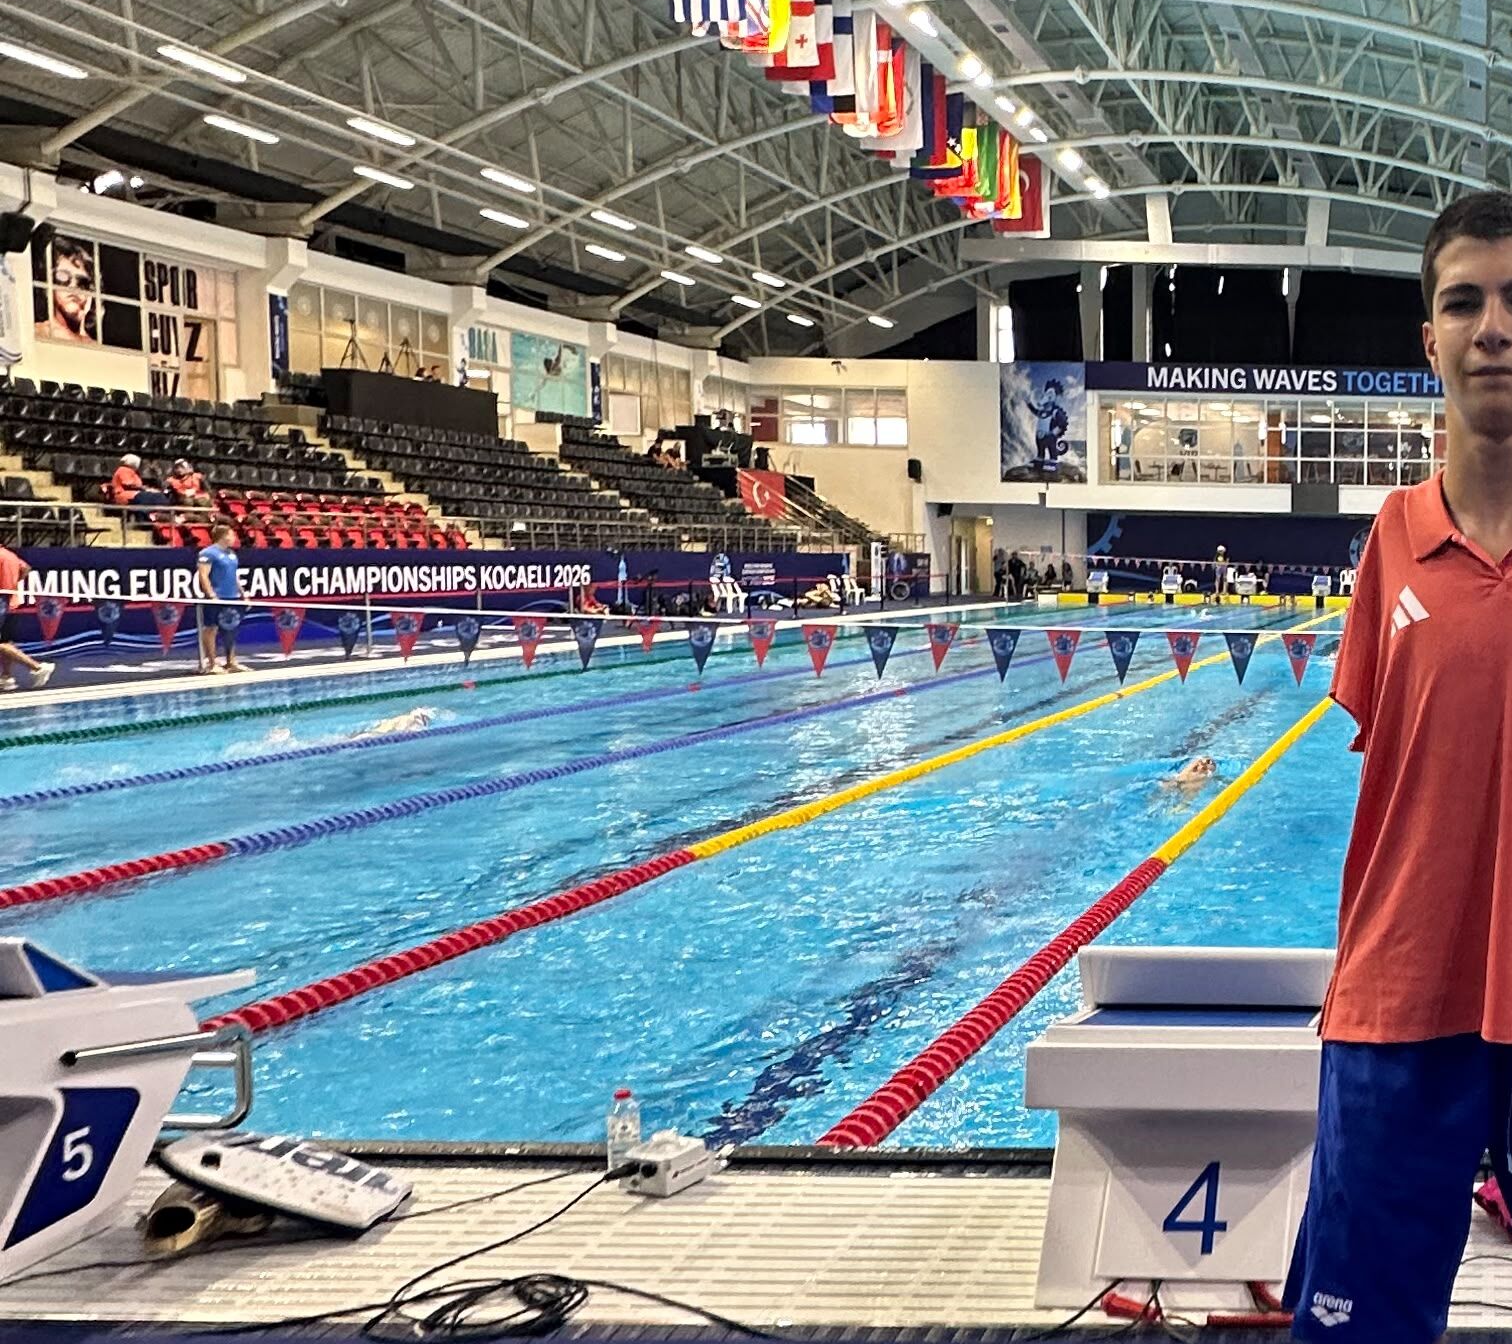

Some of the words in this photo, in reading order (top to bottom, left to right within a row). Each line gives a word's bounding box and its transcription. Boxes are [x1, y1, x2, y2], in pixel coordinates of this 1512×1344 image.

[1147, 366, 1247, 390] MAKING
[1253, 369, 1337, 392] WAVES
[1343, 370, 1442, 393] TOGETH
[293, 565, 477, 596] CHAMPIONSHIPS
[480, 564, 550, 591] KOCAELI
[553, 564, 592, 588] 2026
[61, 1124, 93, 1183] 5
[1162, 1161, 1228, 1255] 4
[1313, 1291, 1353, 1313] arena
